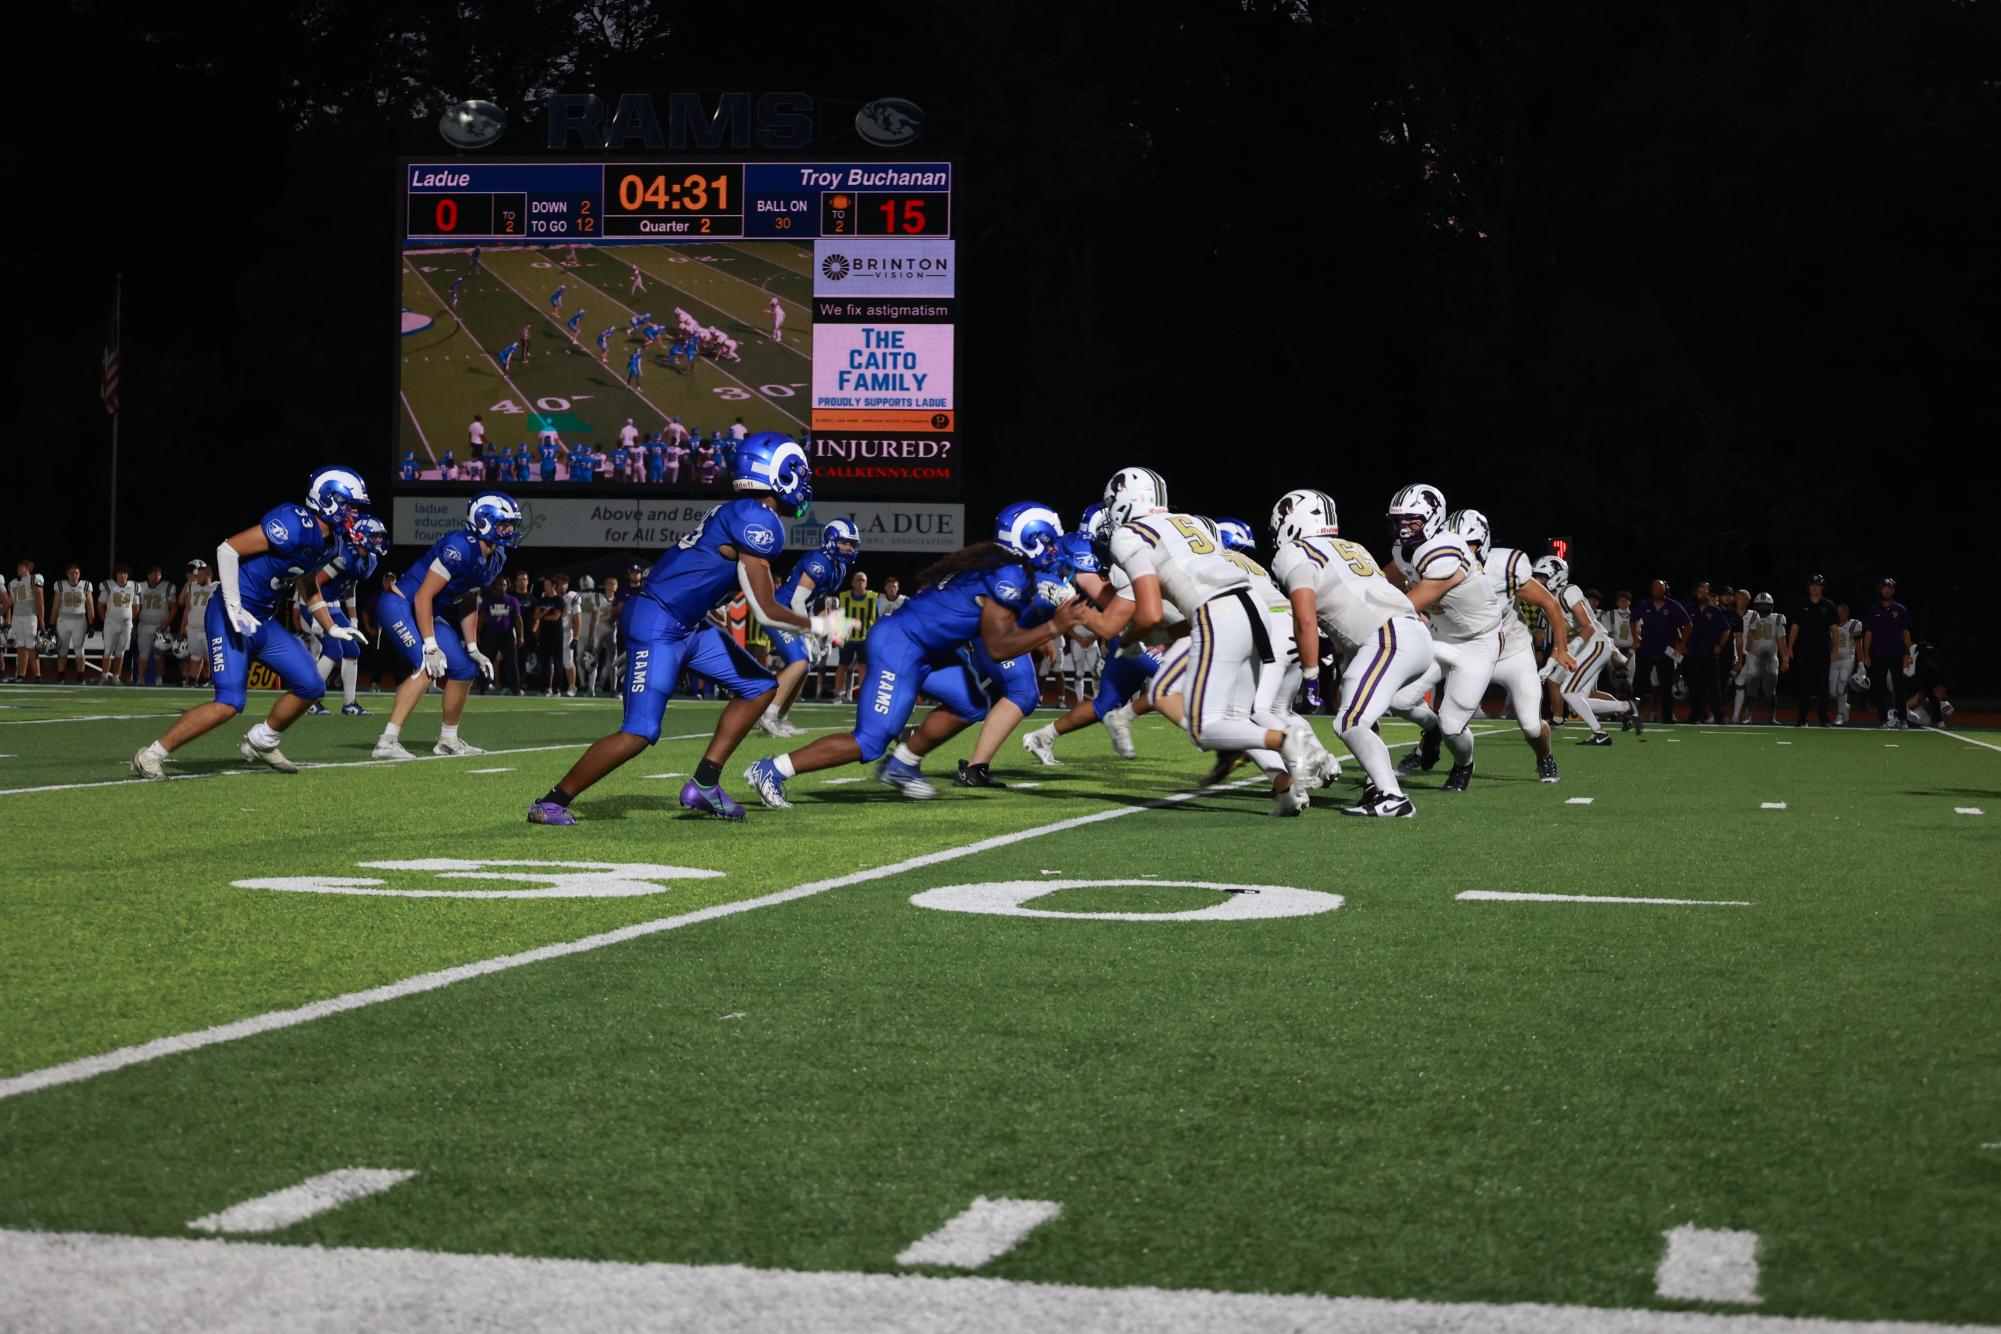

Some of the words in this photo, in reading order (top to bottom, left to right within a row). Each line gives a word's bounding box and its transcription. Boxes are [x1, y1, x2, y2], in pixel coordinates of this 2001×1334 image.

[546, 91, 816, 150] RAMS
[412, 170, 471, 187] Ladue
[800, 169, 843, 190] Troy
[847, 168, 946, 187] Buchanan
[619, 174, 728, 210] 04:31
[531, 201, 567, 213] DOWN
[581, 200, 591, 215] 2
[757, 200, 787, 212] BALL
[790, 200, 808, 212] ON
[435, 198, 458, 232] 0
[502, 211, 516, 220] TO
[832, 210, 846, 219] TO
[880, 200, 927, 234] 15
[505, 220, 514, 232] 2
[531, 220, 547, 232] TO
[549, 220, 567, 232] GO
[576, 217, 595, 232] 12
[640, 220, 690, 233] Quarter
[700, 218, 711, 233] 2
[775, 217, 791, 229] 30
[835, 219, 844, 232] 2
[853, 258, 947, 270] BRINTON
[820, 303, 842, 316] We
[846, 303, 862, 316] fix
[866, 304, 948, 318] astigmatism
[862, 328, 905, 349] THE
[849, 349, 917, 370] CAITO
[838, 370, 927, 391] FAMILY
[817, 397, 861, 407] PROUDLY
[864, 398, 912, 408] SUPPORTS
[915, 398, 947, 408] LADUE
[815, 439, 951, 462] INJURED?
[814, 466, 951, 479] CALLKENNY.COM
[415, 502, 449, 514] ladue
[590, 506, 643, 521] Above
[647, 507, 679, 521] and
[682, 507, 706, 521] Be
[415, 516, 467, 528] educatio
[604, 528, 629, 543] for
[632, 528, 655, 541] All
[660, 528, 687, 542] Stu
[391, 620, 417, 648] RAMS
[211, 636, 225, 673] RAMS
[631, 649, 649, 693] RAMS
[874, 670, 896, 716] RAMS
